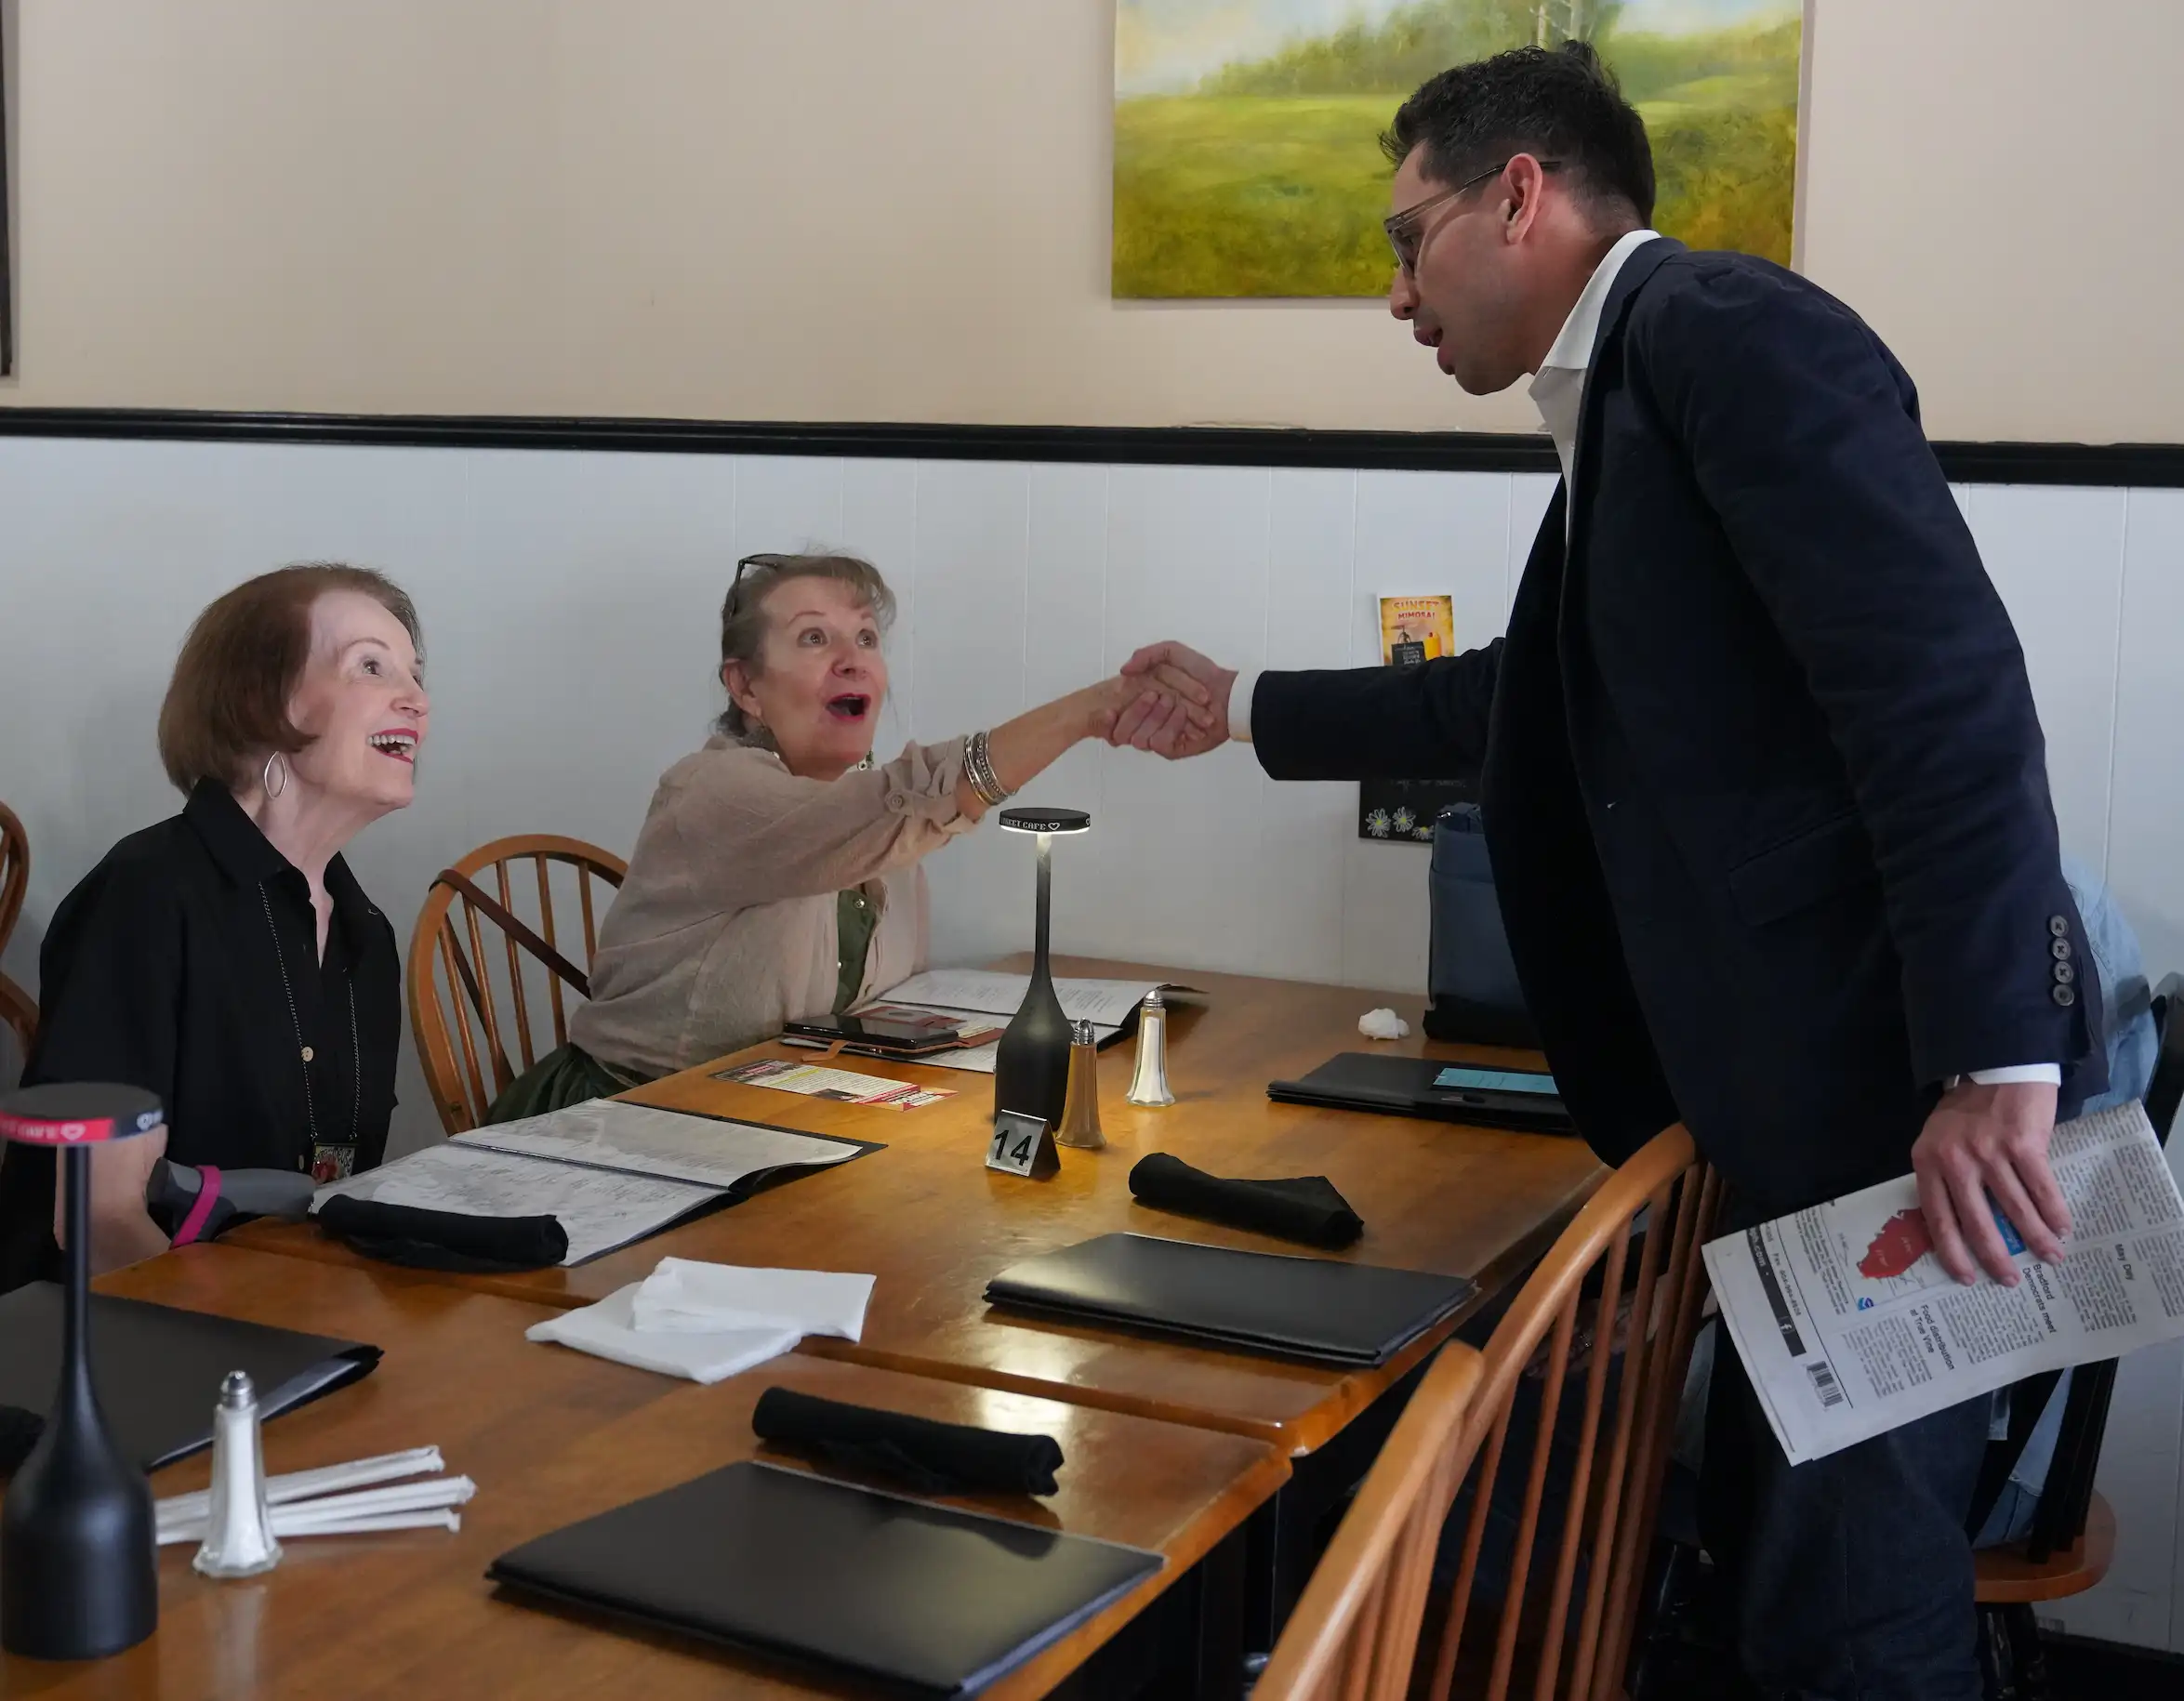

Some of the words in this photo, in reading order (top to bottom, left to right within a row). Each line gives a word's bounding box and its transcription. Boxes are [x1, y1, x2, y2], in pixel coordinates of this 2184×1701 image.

[1392, 600, 1440, 613] SUNSET
[1397, 612, 1436, 620] MIMOSA!
[994, 1129, 1032, 1167] 14
[2114, 1244, 2126, 1261] May
[2123, 1263, 2135, 1281] Day
[2032, 1263, 2055, 1300] Bradford
[2022, 1267, 2046, 1312] Democrats
[2042, 1312, 2057, 1334] meet
[1910, 1309, 1919, 1317] at
[1915, 1316, 1926, 1335] True
[1923, 1335, 1934, 1353] Vine
[1921, 1304, 1935, 1325] Food
[1930, 1325, 1954, 1371] distribution
